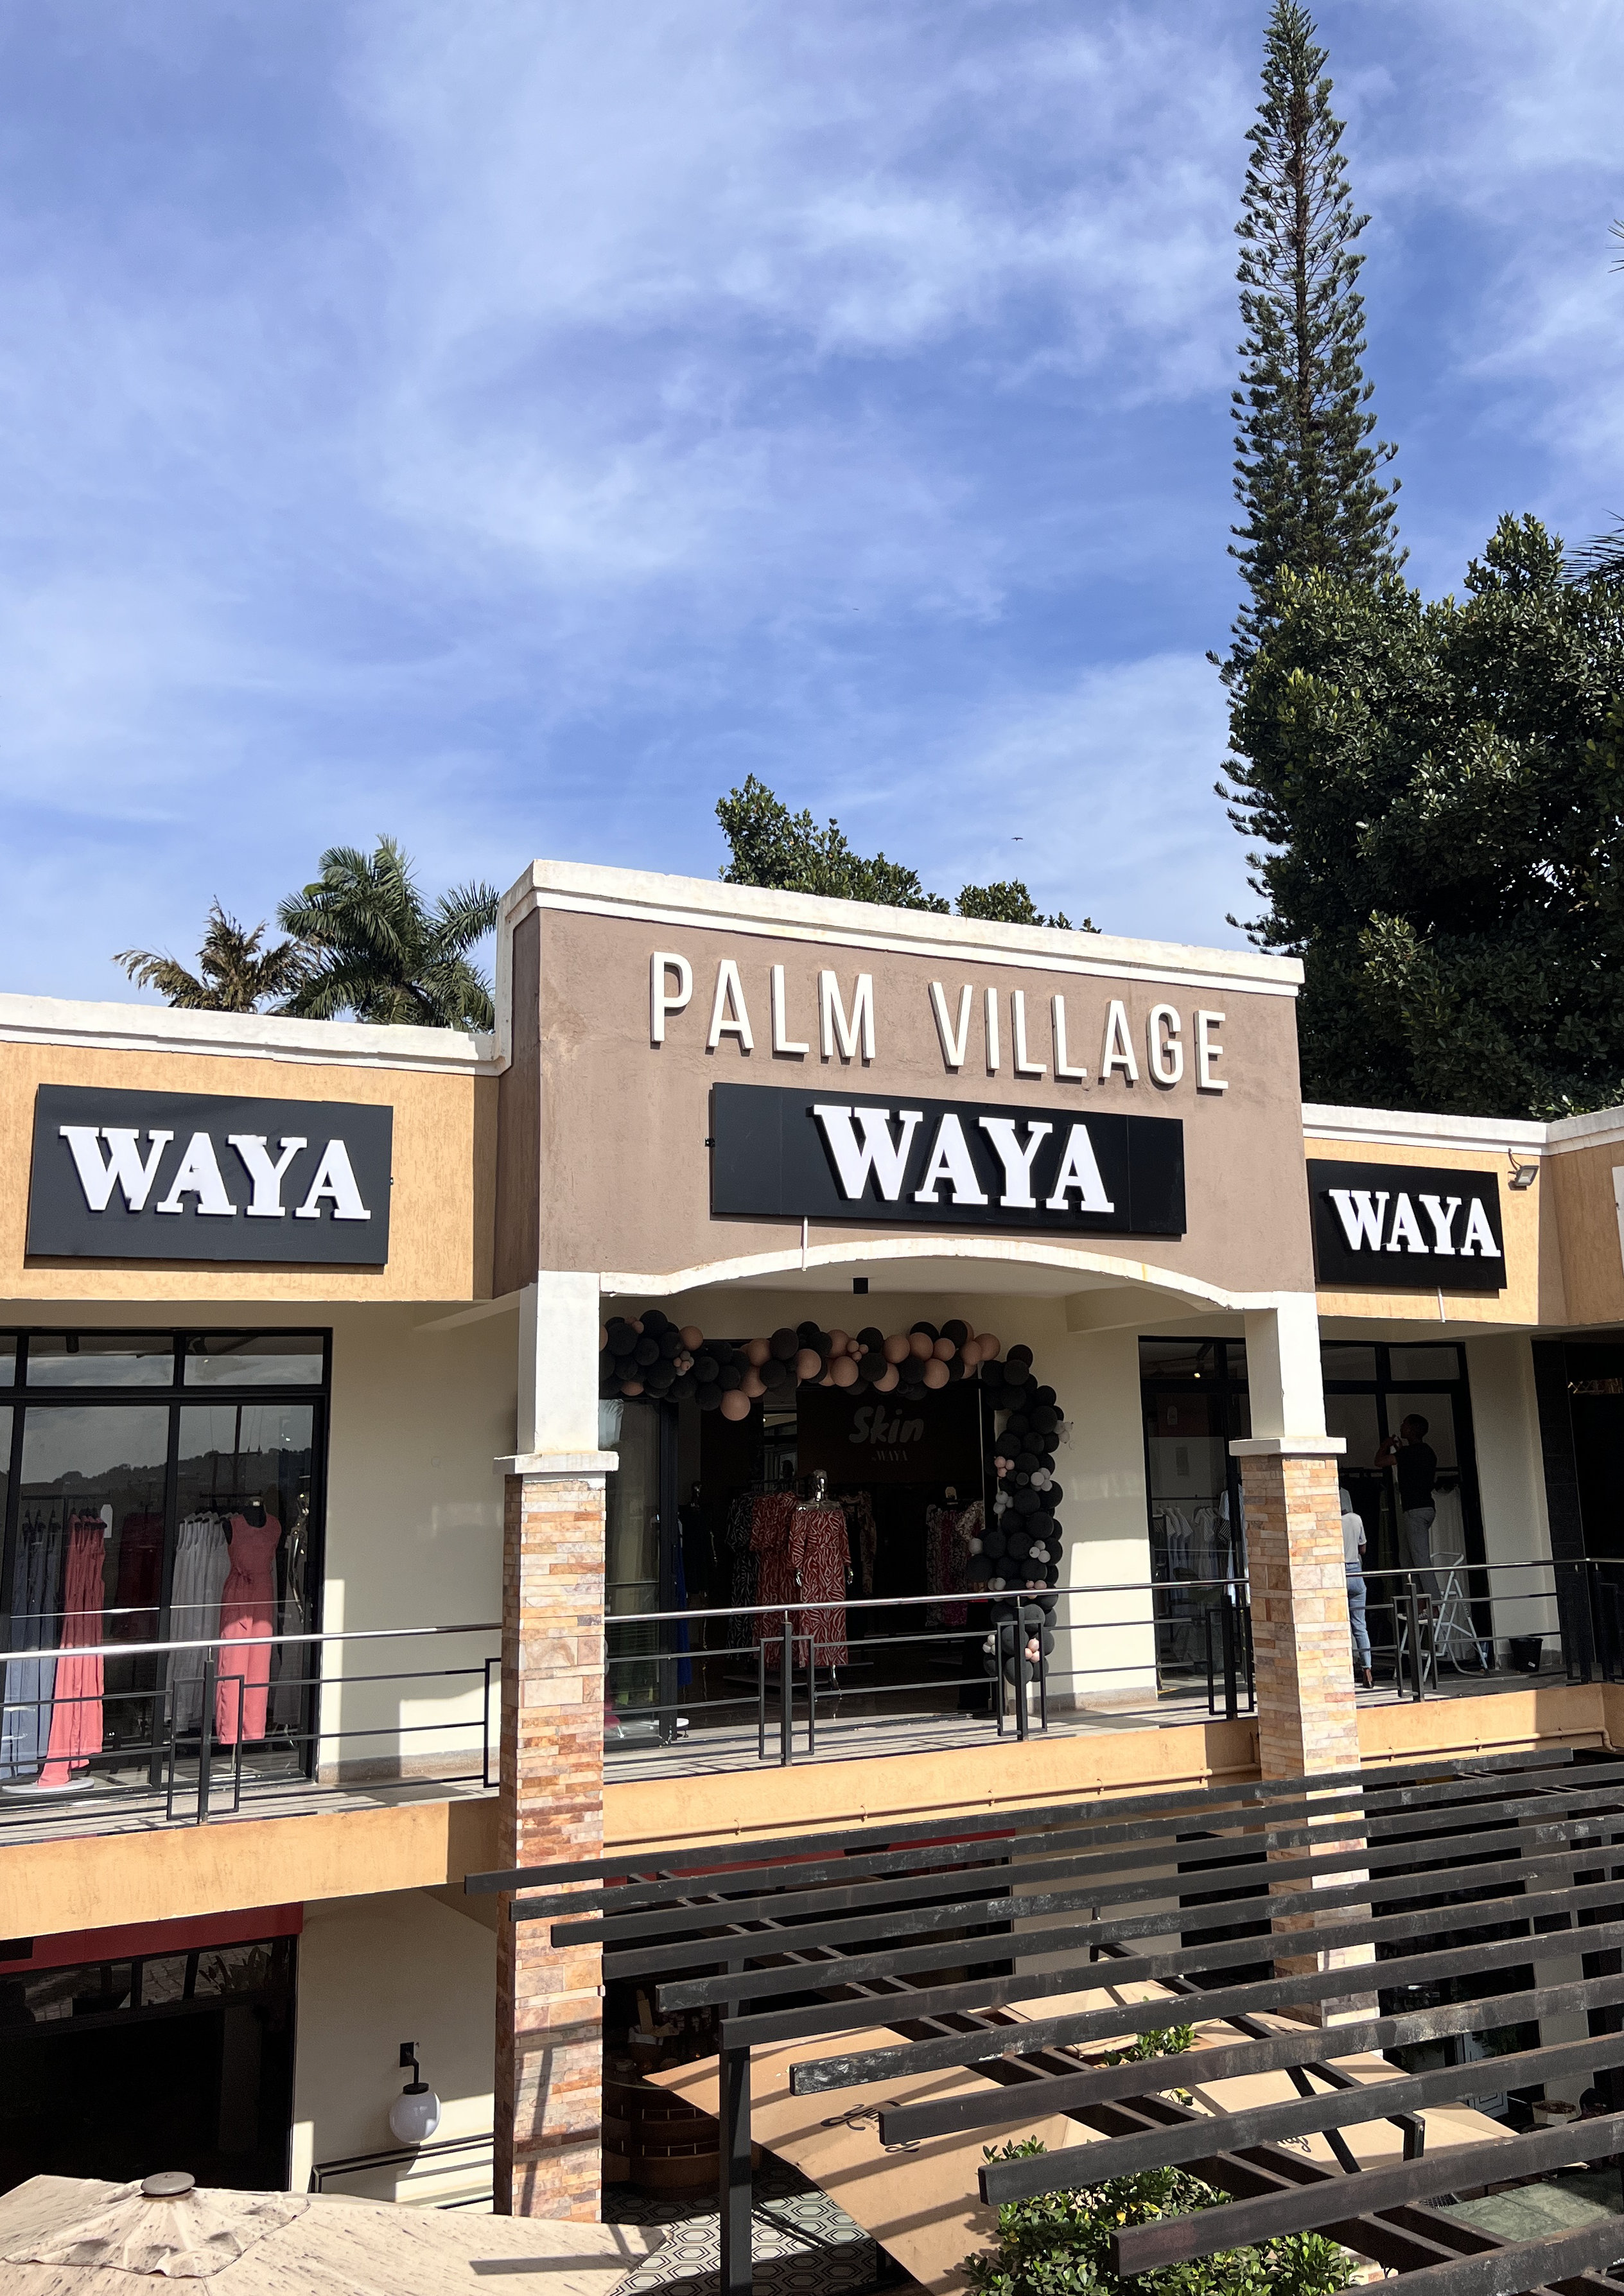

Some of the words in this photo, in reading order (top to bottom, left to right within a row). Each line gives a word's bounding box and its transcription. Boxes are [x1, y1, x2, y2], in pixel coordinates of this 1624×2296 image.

[650, 951, 875, 1060] PALM
[928, 981, 1228, 1091] VILLAGE
[59, 1125, 372, 1220] WAYA
[813, 1103, 1115, 1213] WAYA
[1328, 1188, 1502, 1258] WAYA
[848, 1405, 925, 1444] Skin
[876, 1450, 908, 1461] WAYA
